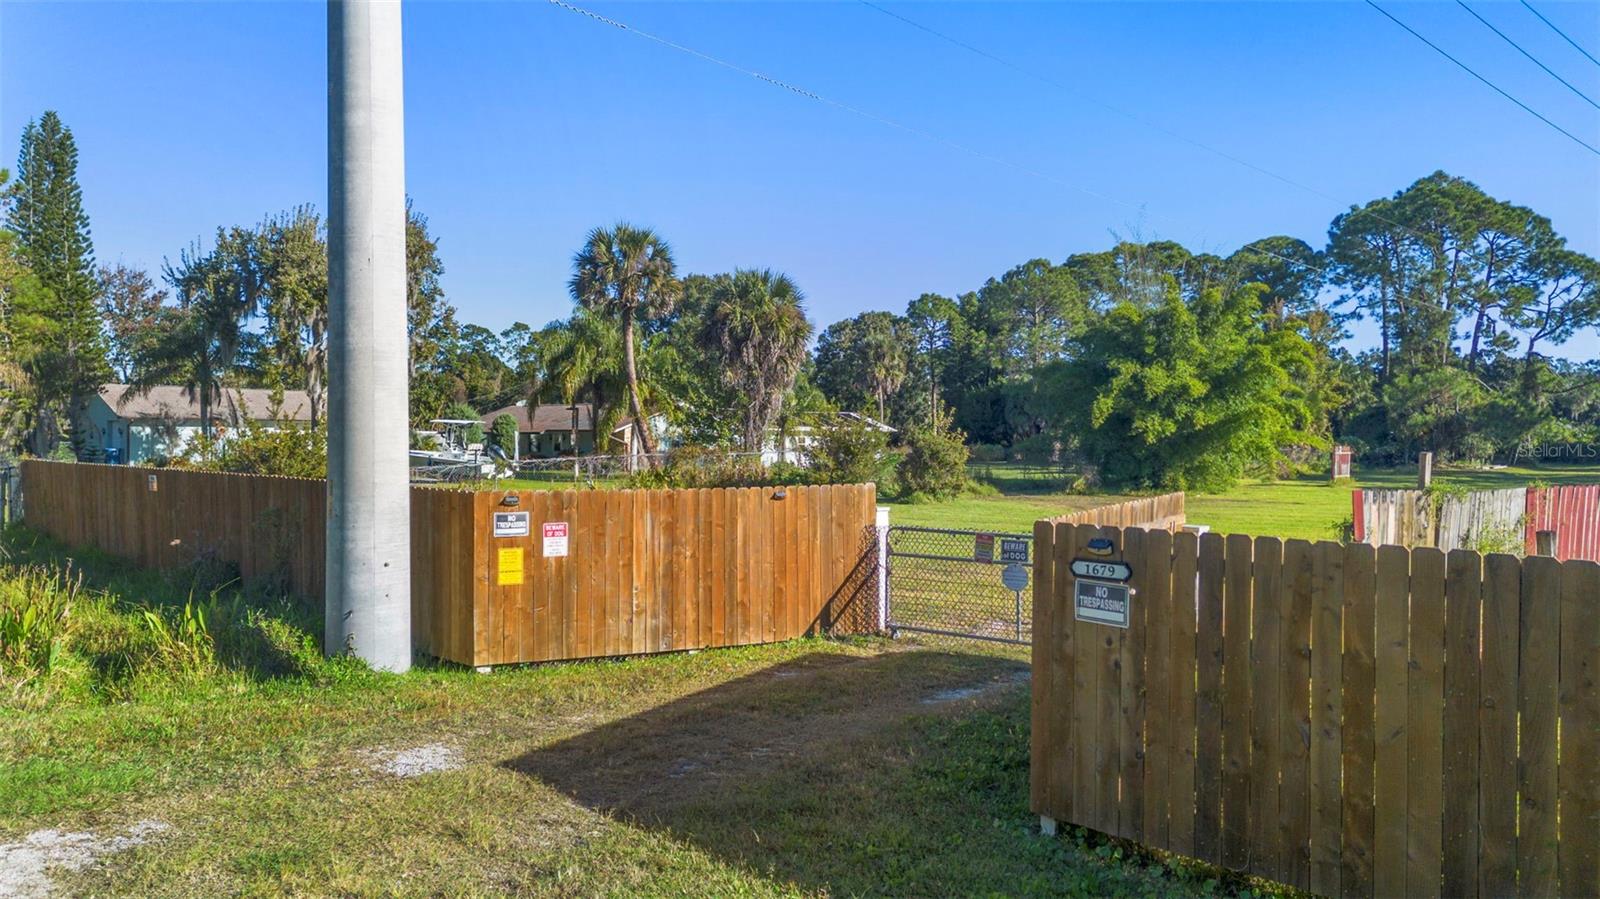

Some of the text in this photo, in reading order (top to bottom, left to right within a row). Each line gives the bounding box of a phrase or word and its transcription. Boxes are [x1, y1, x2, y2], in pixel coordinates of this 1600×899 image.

[1003, 542, 1026, 551] BEWARE
[1010, 552, 1026, 561] DOG
[1085, 564, 1115, 577] 1679
[1096, 586, 1108, 598] NO
[1080, 595, 1124, 612] TRESPASSING
